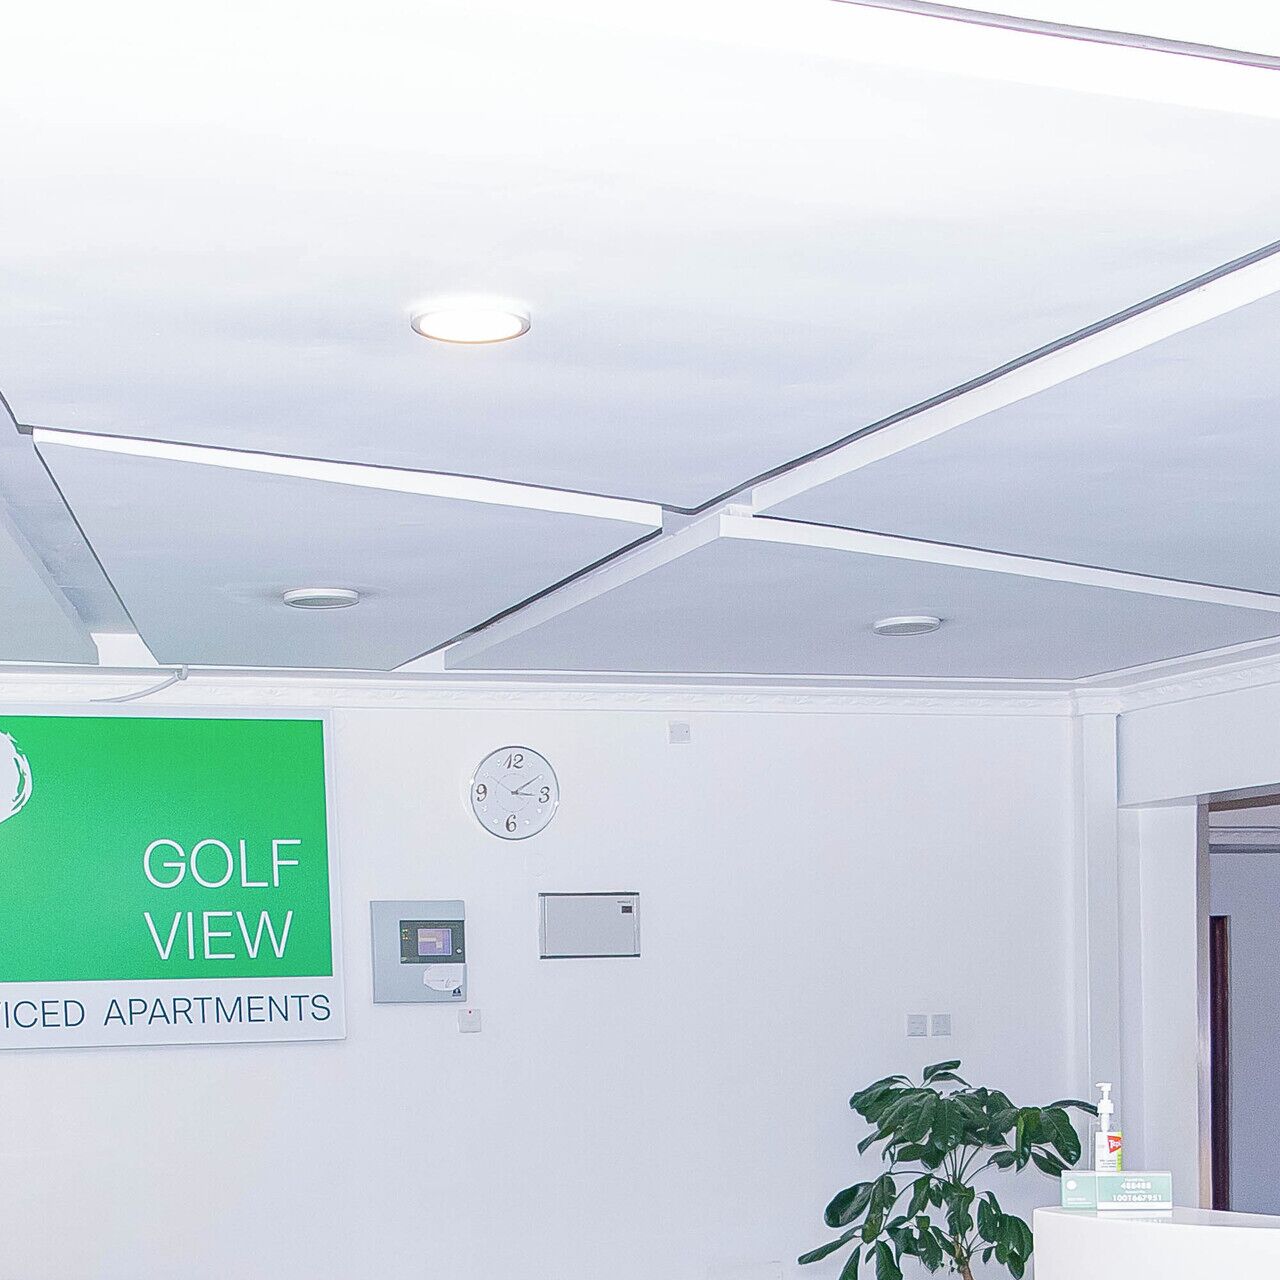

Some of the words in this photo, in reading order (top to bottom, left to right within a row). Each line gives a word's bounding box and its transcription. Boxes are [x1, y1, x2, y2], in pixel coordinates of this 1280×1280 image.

[503, 753, 523, 769] 12
[476, 783, 488, 802] 9
[538, 786, 550, 804] 3
[505, 814, 517, 832] 6
[143, 838, 302, 889] GOLF
[143, 910, 293, 960] VIEW
[103, 994, 332, 1027] APARTMENTS
